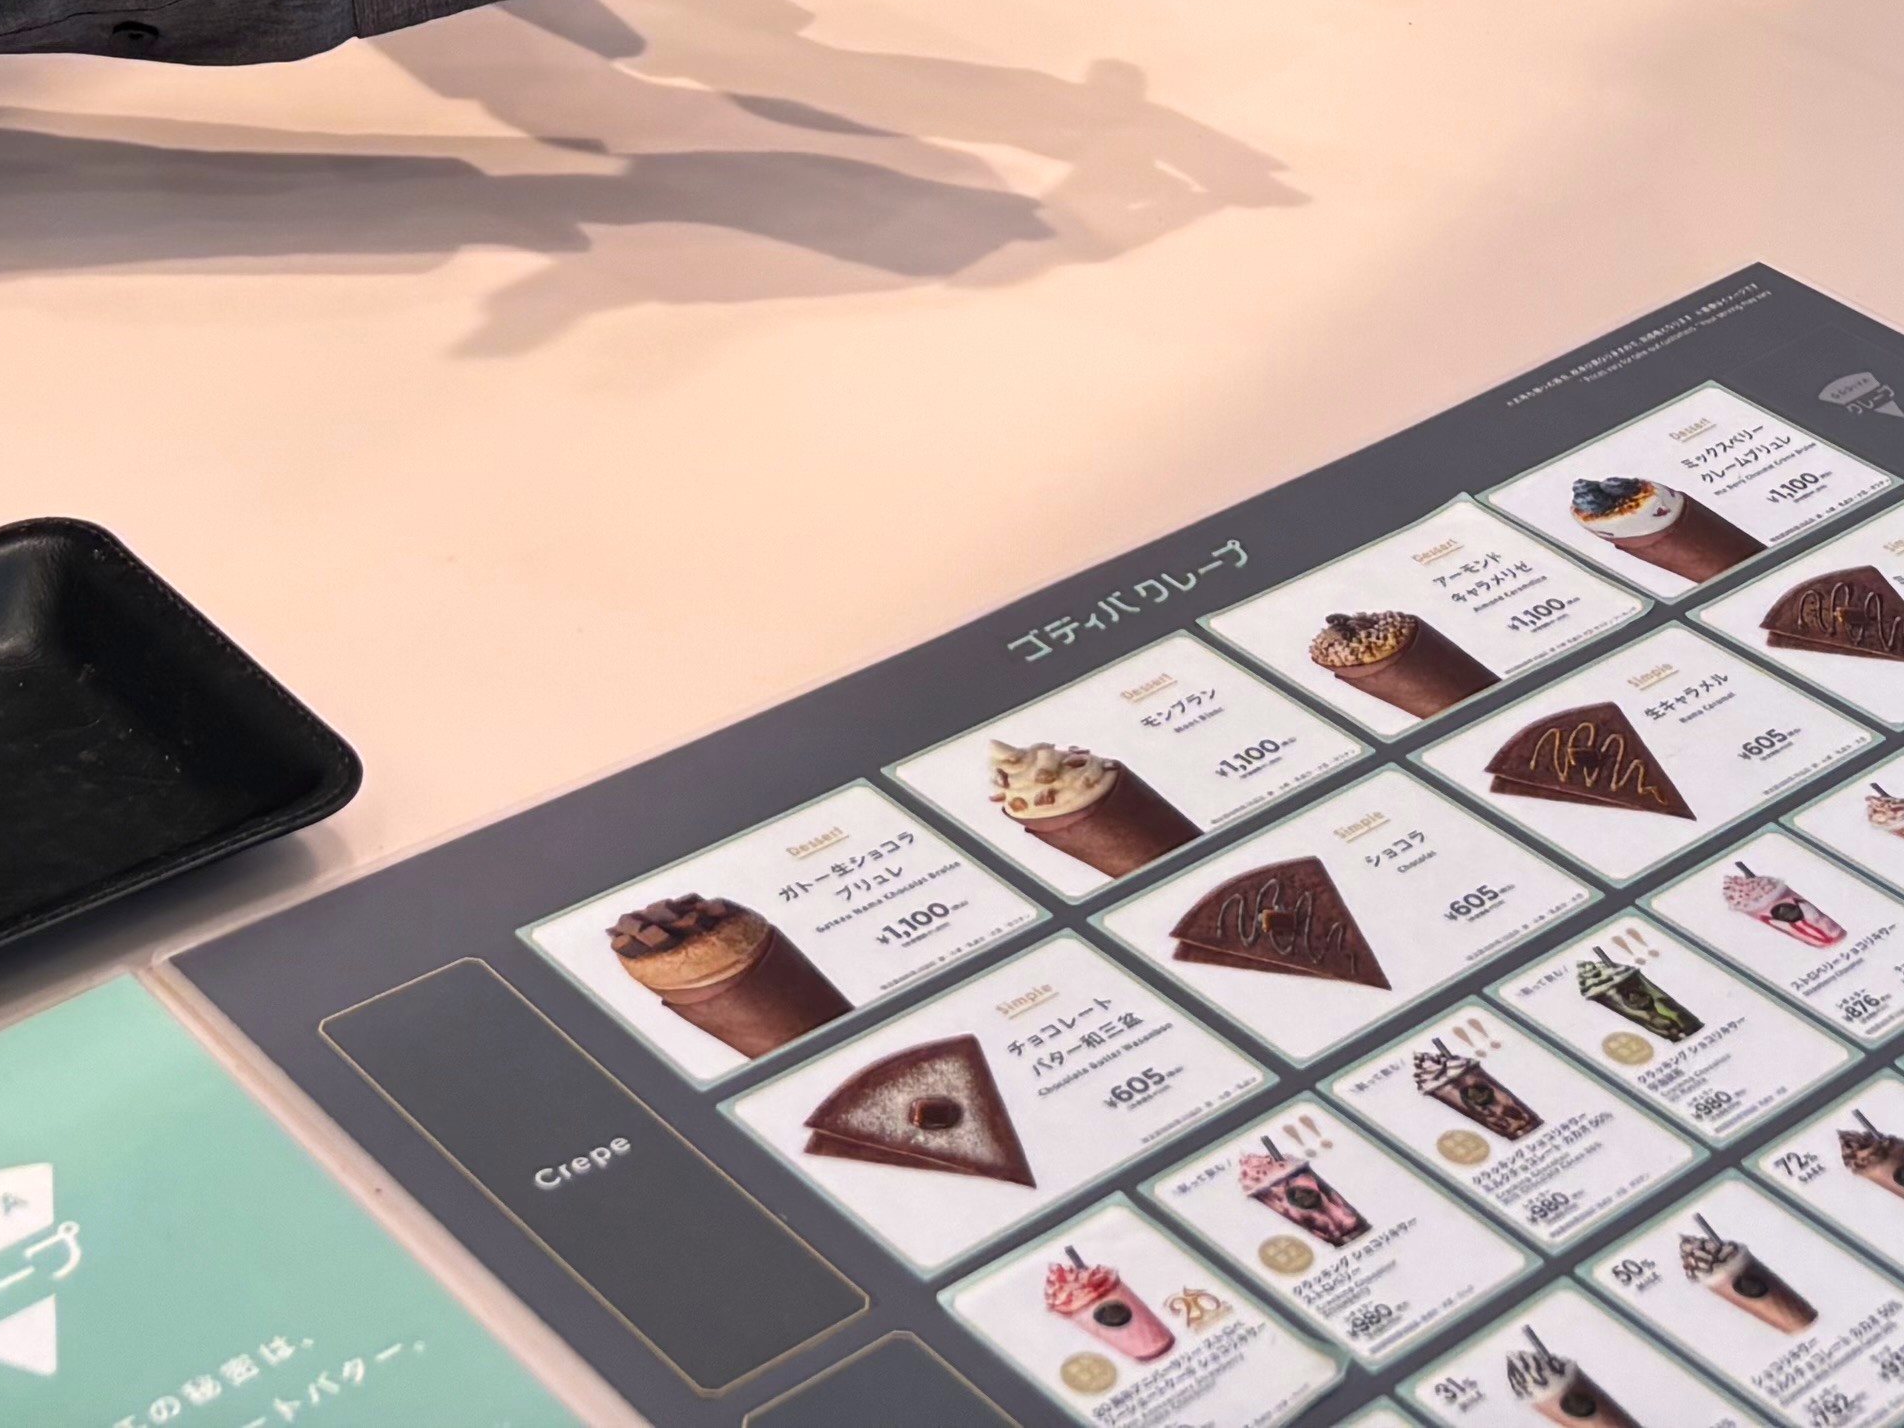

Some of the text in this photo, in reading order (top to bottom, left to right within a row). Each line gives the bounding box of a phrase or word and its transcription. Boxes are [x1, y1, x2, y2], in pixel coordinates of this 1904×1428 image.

[1842, 385, 1895, 414] クレープ
[1669, 418, 1710, 441] Dessert
[1681, 426, 1763, 468] ミックスベリー
[1701, 436, 1790, 483] クレームブリュレ
[1767, 473, 1819, 503] ¥1,100
[1411, 539, 1457, 563] Dessert
[1433, 553, 1501, 587] アーモンド
[1451, 561, 1532, 602] キャラメリゼ
[1007, 540, 1248, 661] ゴディバ クレープ
[1508, 599, 1565, 631] ¥1,100
[1120, 673, 1172, 701] Dessert
[1627, 664, 1673, 688] Simple
[1141, 689, 1215, 727] モンブラン
[1644, 674, 1728, 720] 生キャラメル
[1216, 740, 1280, 777] ¥1,100
[1738, 729, 1787, 760] ¥605
[786, 827, 843, 857] Dessert
[1333, 812, 1385, 839] Simple
[1365, 830, 1424, 867] ショコラ
[779, 832, 914, 902] ガトー生ショコラ
[835, 867, 902, 901] ブリュレ
[1444, 885, 1499, 920] ¥605
[876, 903, 949, 944] ¥1,100
[996, 984, 1052, 1016] Simple
[1844, 995, 1880, 1022] ¥876
[1008, 999, 1111, 1056] チョコレート
[1033, 1013, 1144, 1077] バター和三盆
[1104, 1068, 1165, 1108] ¥605
[1693, 1092, 1732, 1120] ¥980
[533, 1137, 632, 1192] Crepe
[1774, 1153, 1817, 1176] 72%
[1528, 1193, 1569, 1224] ¥980
[1612, 1260, 1655, 1286] 50%
[1349, 1304, 1393, 1338] ¥980
